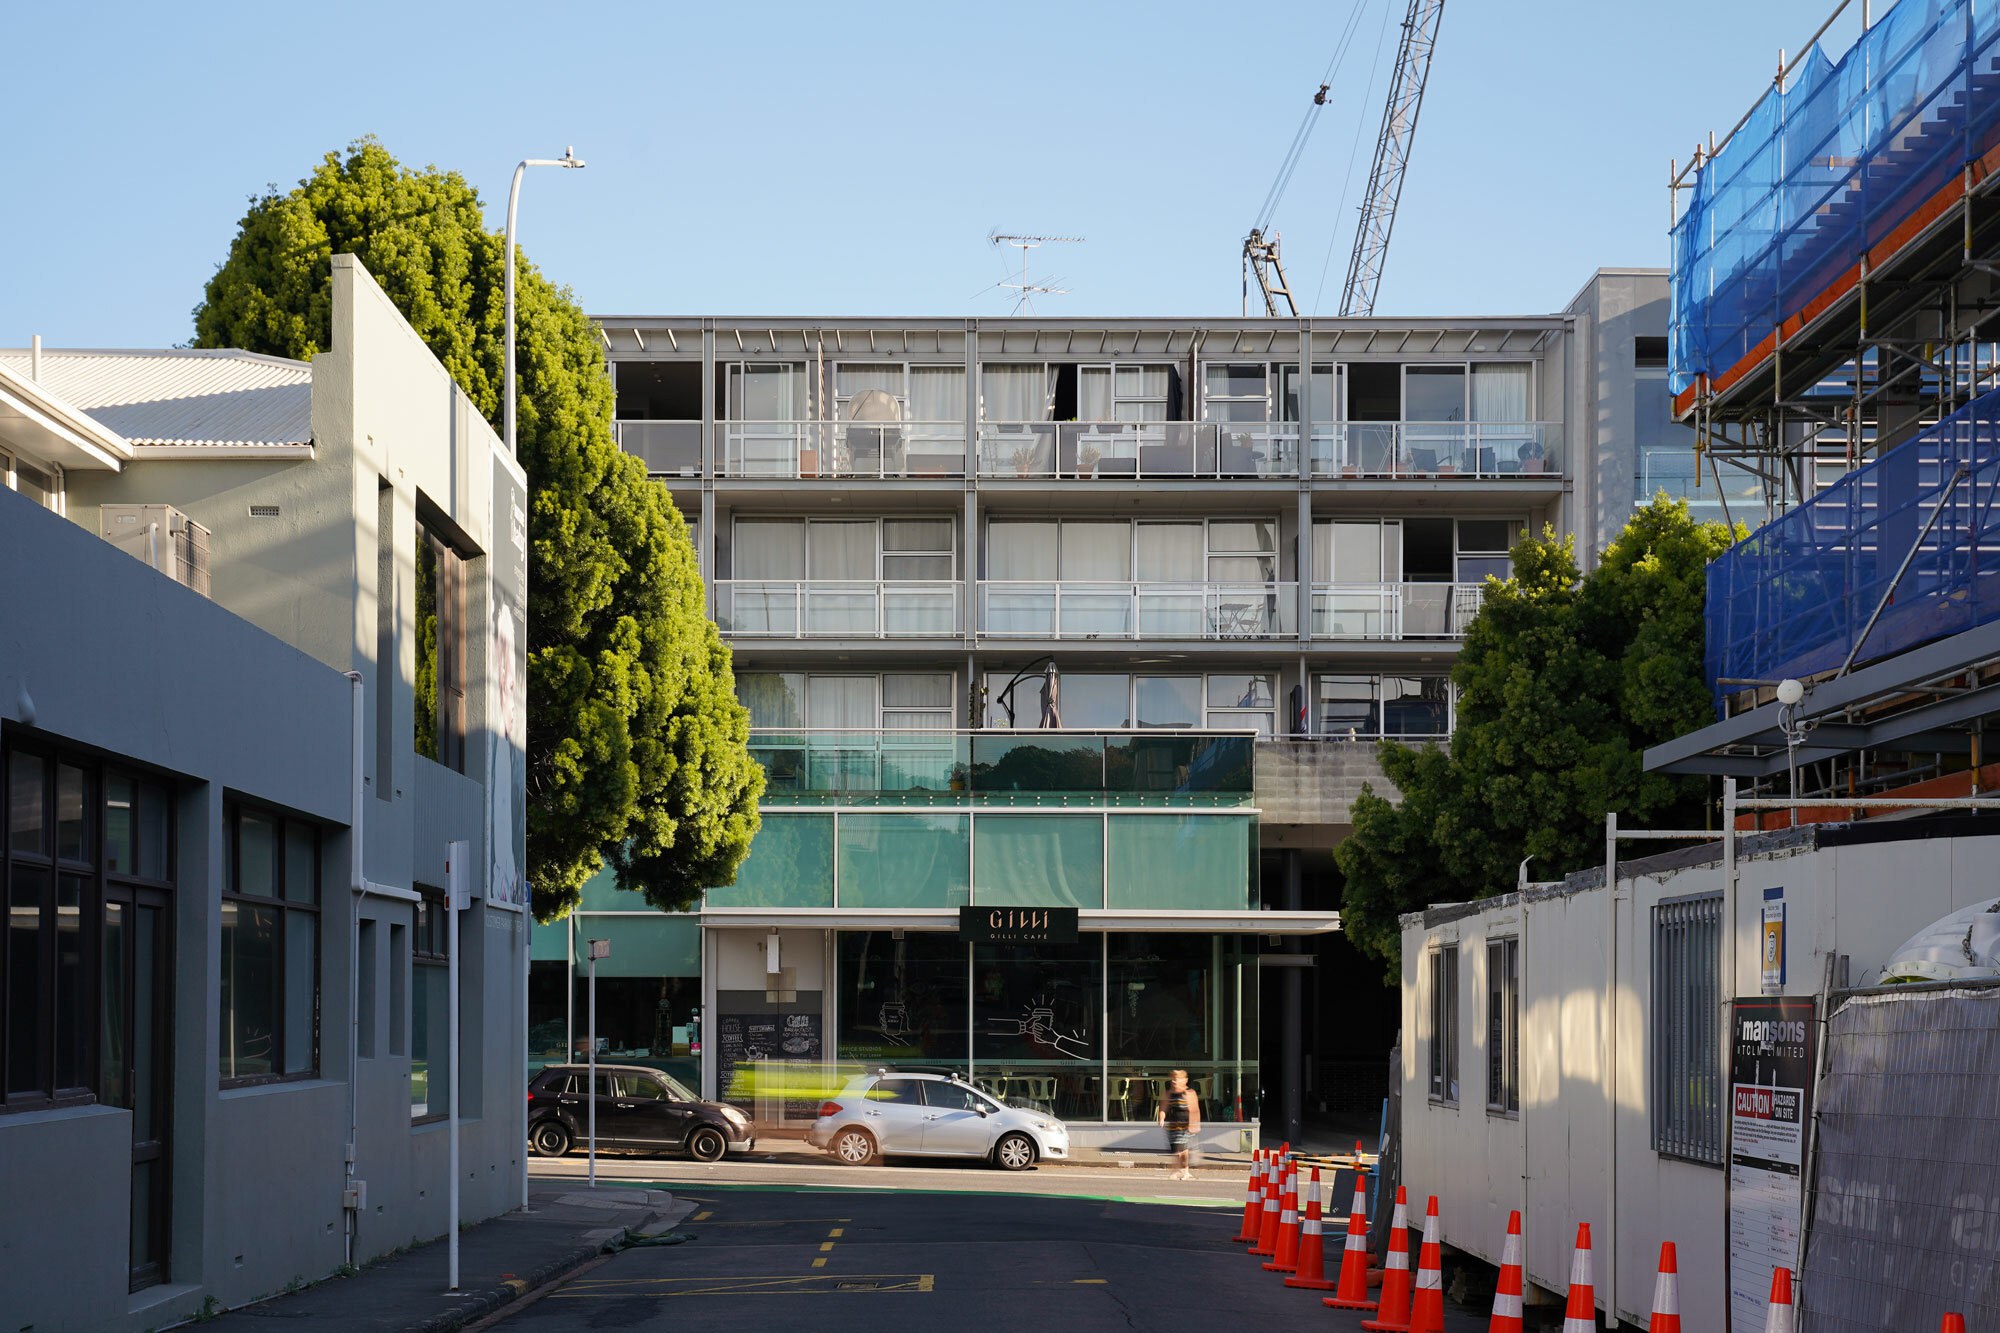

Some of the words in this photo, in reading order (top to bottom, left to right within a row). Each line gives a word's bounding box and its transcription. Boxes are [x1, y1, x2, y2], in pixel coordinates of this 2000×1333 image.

[1742, 1020, 1805, 1043] mansons
[1768, 1046, 1804, 1058] LIMITED
[1737, 1092, 1770, 1114] CAUTION
[1773, 1094, 1796, 1107] HAZARDS
[1775, 1107, 1782, 1118] ON
[1783, 1108, 1793, 1119] SITE
